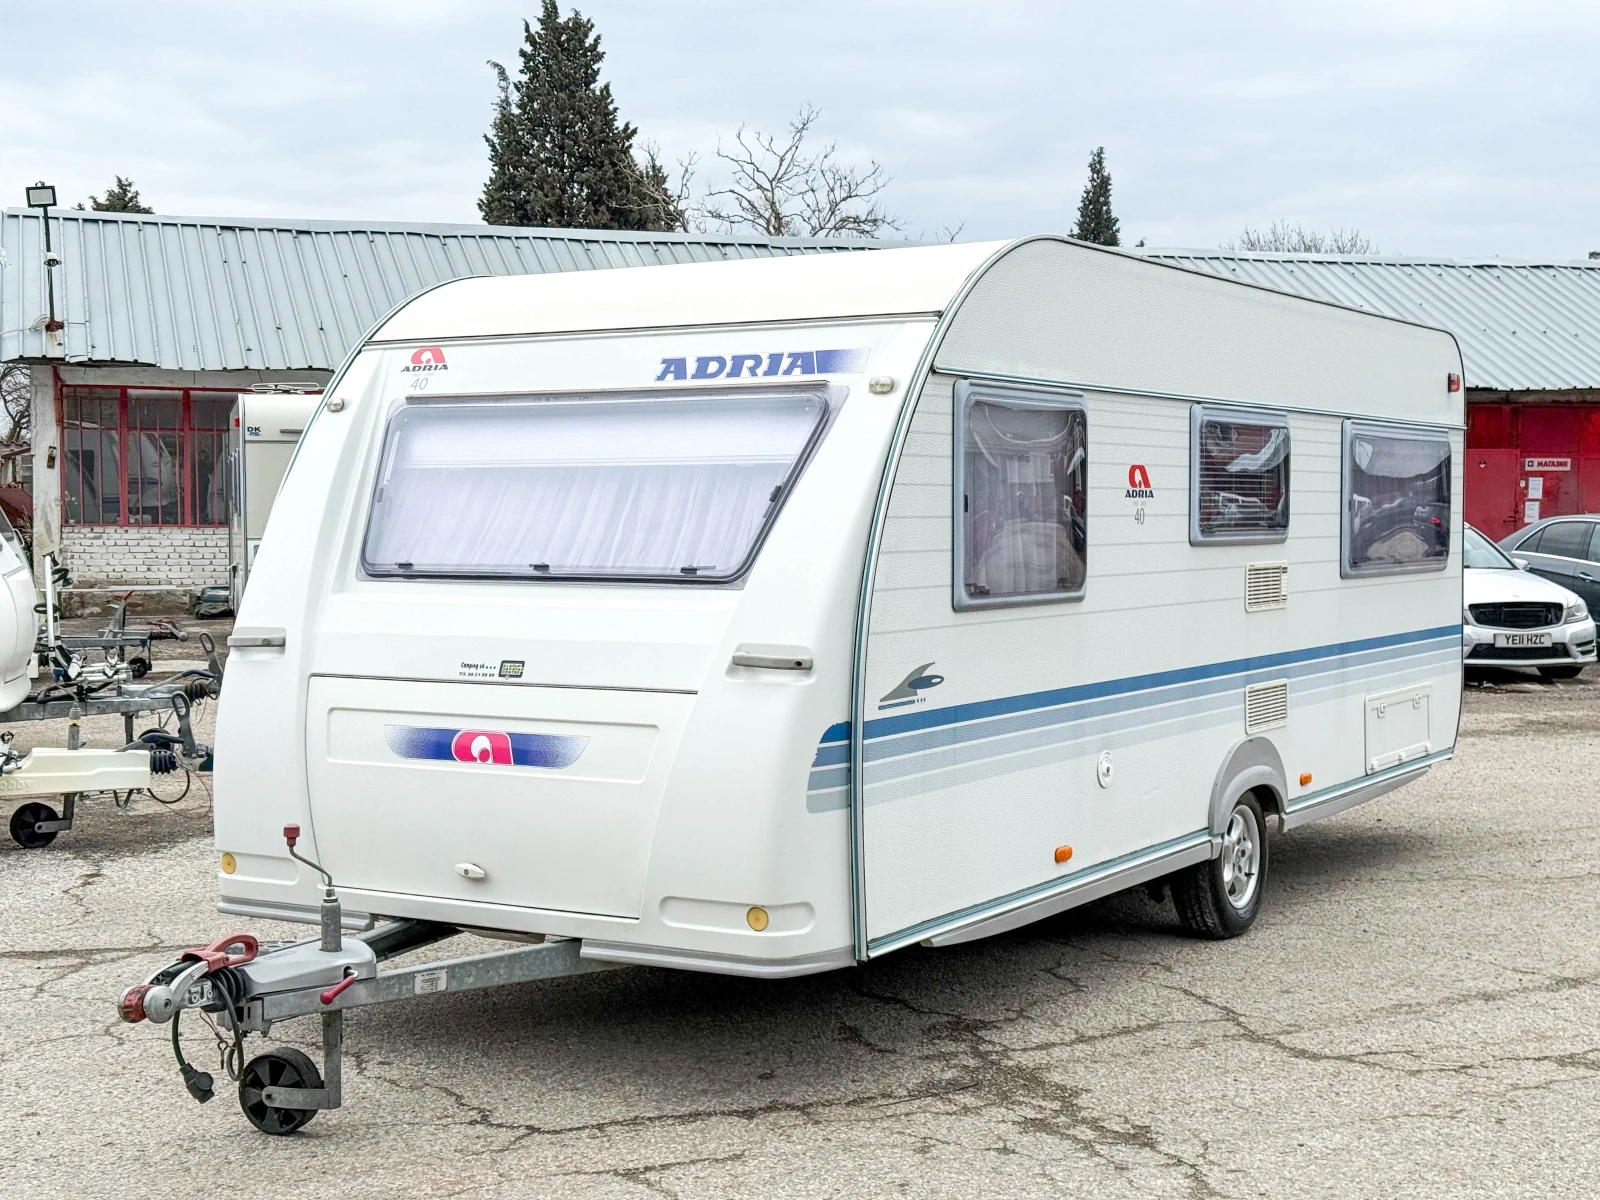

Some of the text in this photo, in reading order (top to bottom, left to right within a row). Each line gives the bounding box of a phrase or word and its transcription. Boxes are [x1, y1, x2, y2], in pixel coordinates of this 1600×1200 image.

[401, 364, 448, 372] ADRIA
[655, 351, 816, 381] ADRIA
[410, 377, 429, 390] 40
[1537, 460, 1568, 468] МАГАЗИН
[1125, 490, 1154, 498] ADRIA
[1134, 507, 1145, 525] 40
[1505, 634, 1545, 645] YE11 HZC
